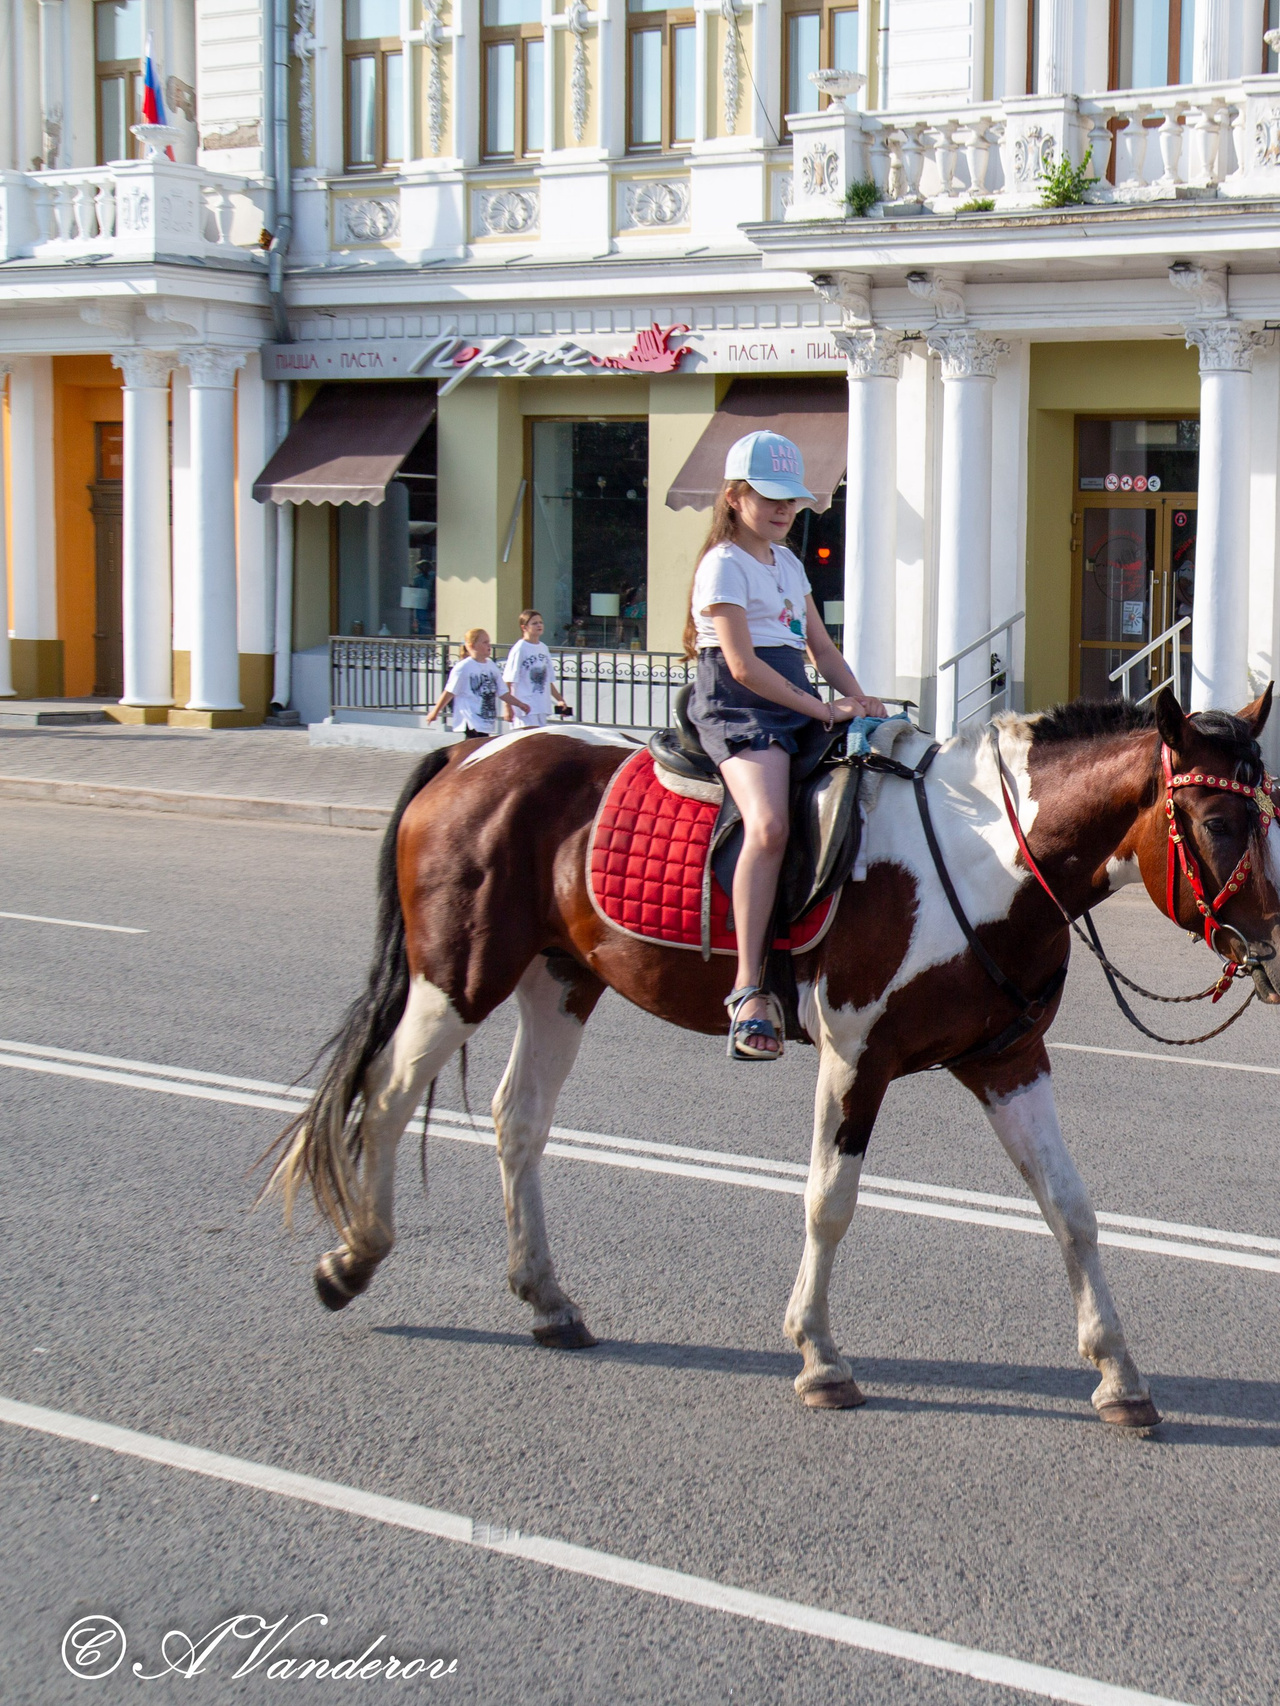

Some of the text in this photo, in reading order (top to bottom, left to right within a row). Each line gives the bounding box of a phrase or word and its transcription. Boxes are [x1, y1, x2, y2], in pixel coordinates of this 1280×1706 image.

[275, 353, 319, 369] ПИЦЦА
[340, 351, 384, 368] ПАСТА
[728, 343, 778, 361] ПАСТА
[806, 342, 848, 360] ПИЦЦ
[768, 444, 797, 460] LAZY
